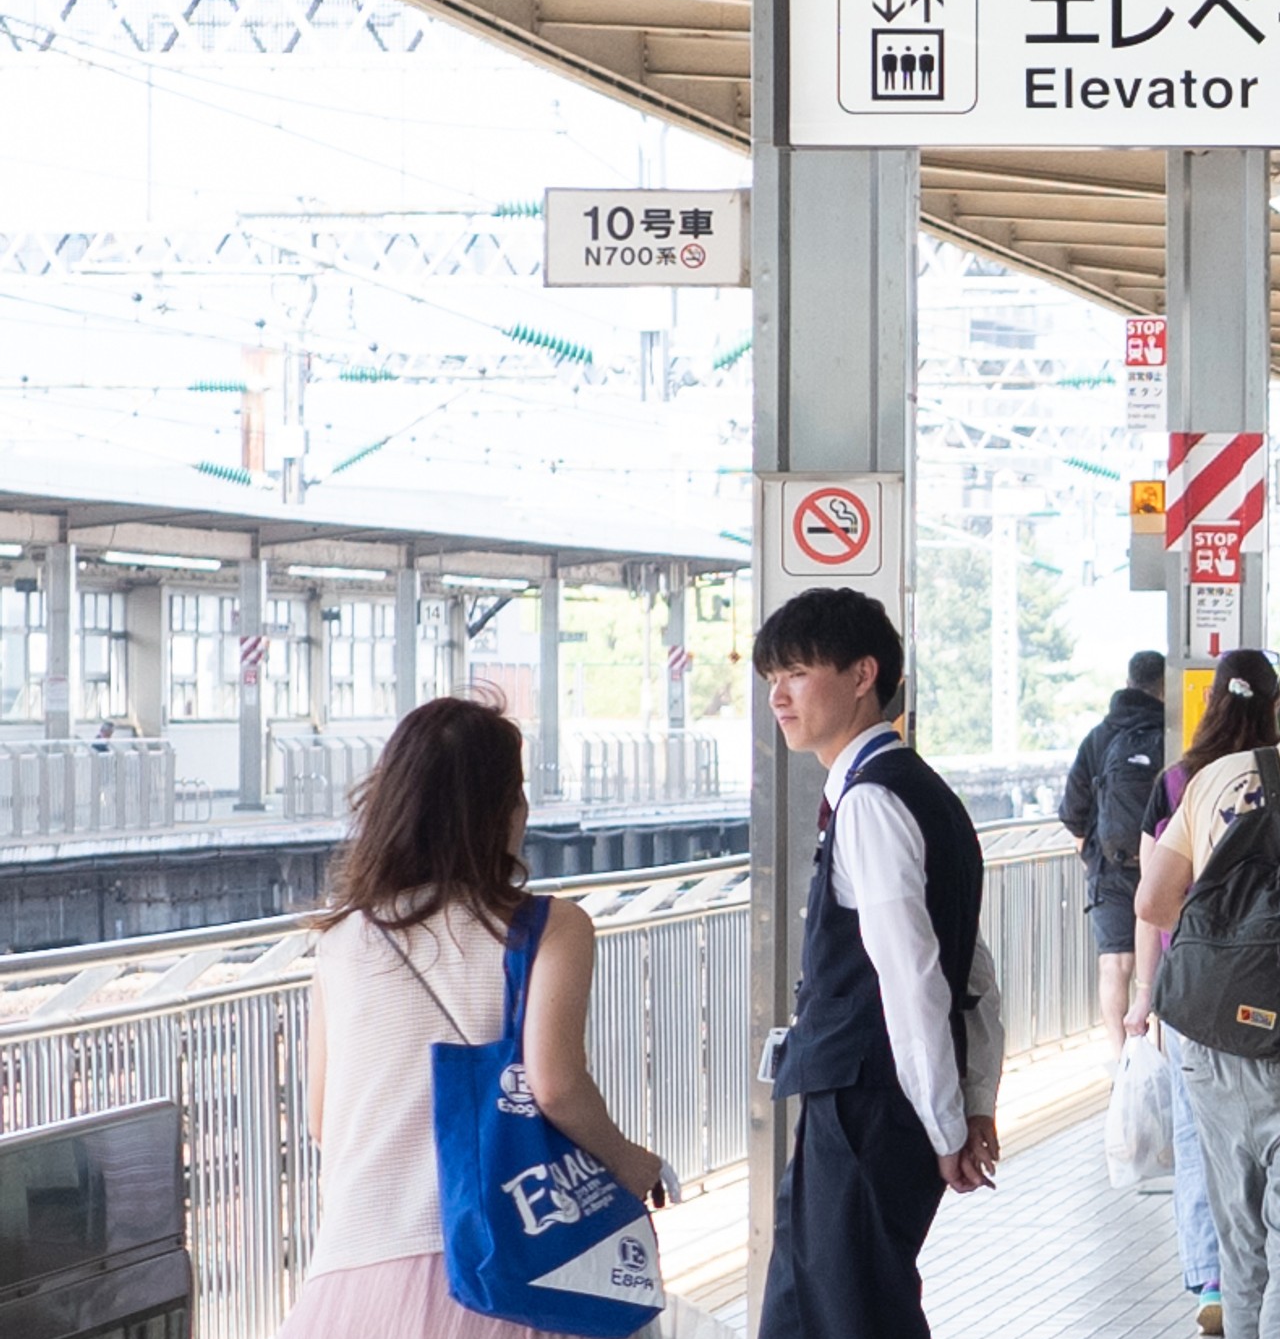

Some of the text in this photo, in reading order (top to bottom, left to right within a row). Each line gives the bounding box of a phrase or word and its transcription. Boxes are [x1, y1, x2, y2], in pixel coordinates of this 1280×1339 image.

[1025, 67, 1260, 110] Elevator
[583, 205, 714, 241] 10号車
[584, 246, 677, 267] N700系
[1126, 321, 1165, 336] STOP
[1194, 532, 1238, 547] STOP
[424, 604, 441, 621] 14
